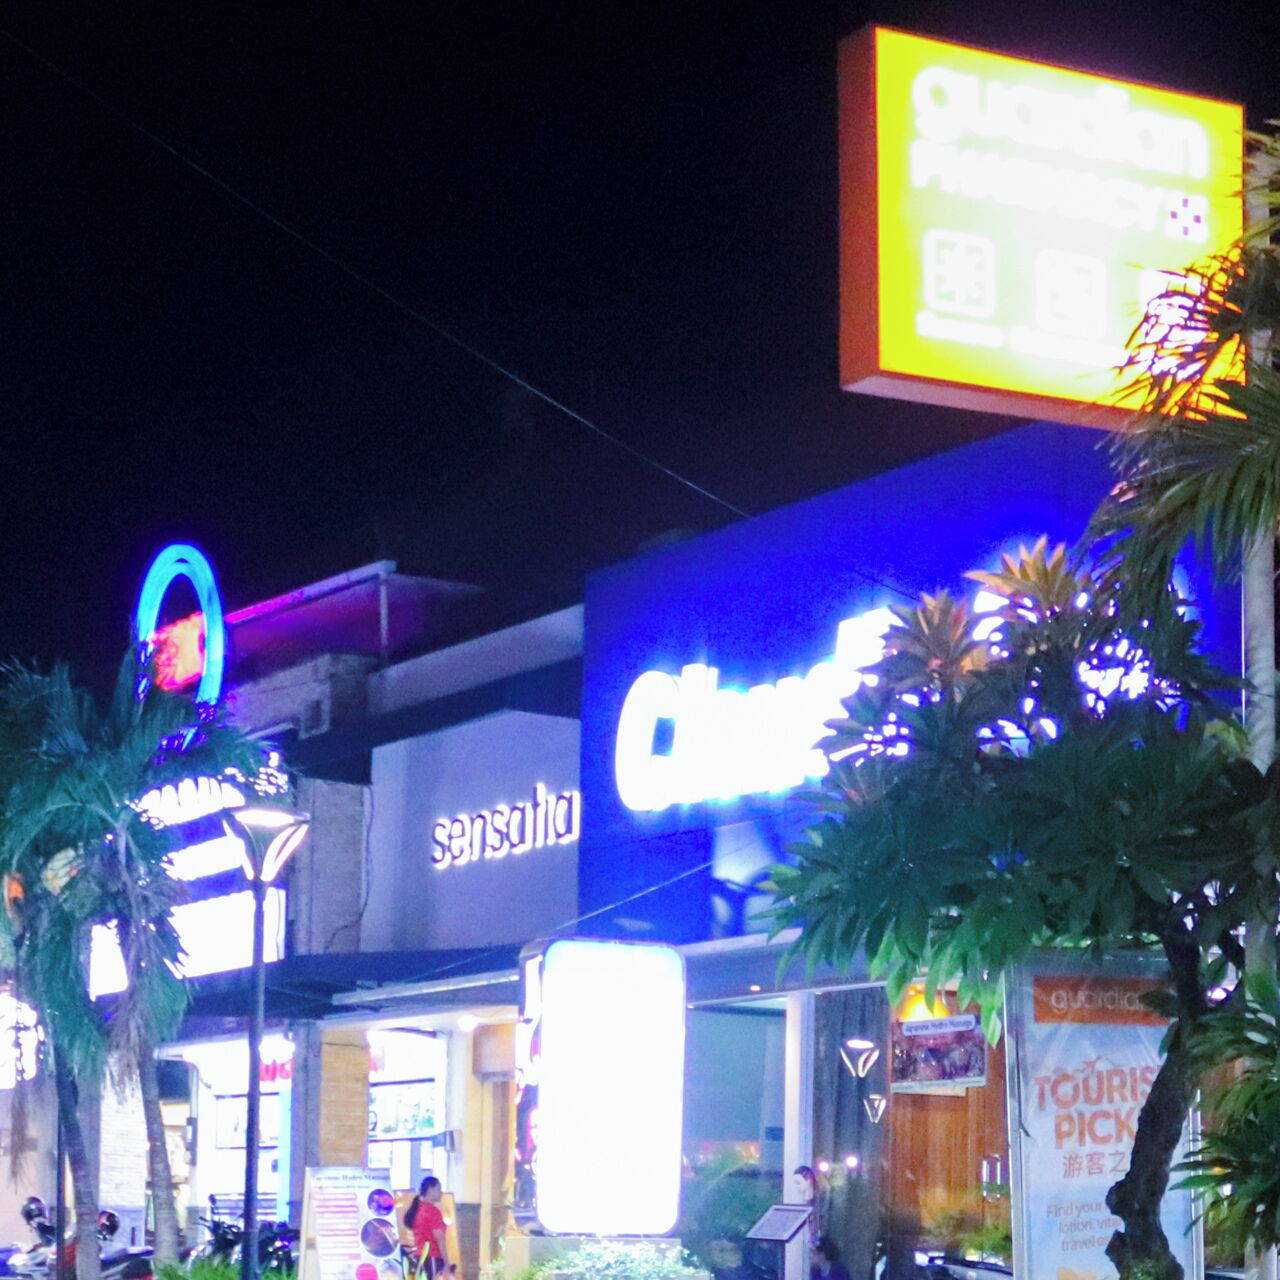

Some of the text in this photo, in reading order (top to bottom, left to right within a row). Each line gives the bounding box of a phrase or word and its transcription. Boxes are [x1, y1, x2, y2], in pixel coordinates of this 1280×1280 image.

[431, 781, 580, 871] sensatia
[1050, 985, 1145, 1014] guardia
[1034, 1064, 1161, 1112] TOURIS
[1054, 1106, 1137, 1150] PICK
[1062, 1150, 1129, 1180] 游客之
